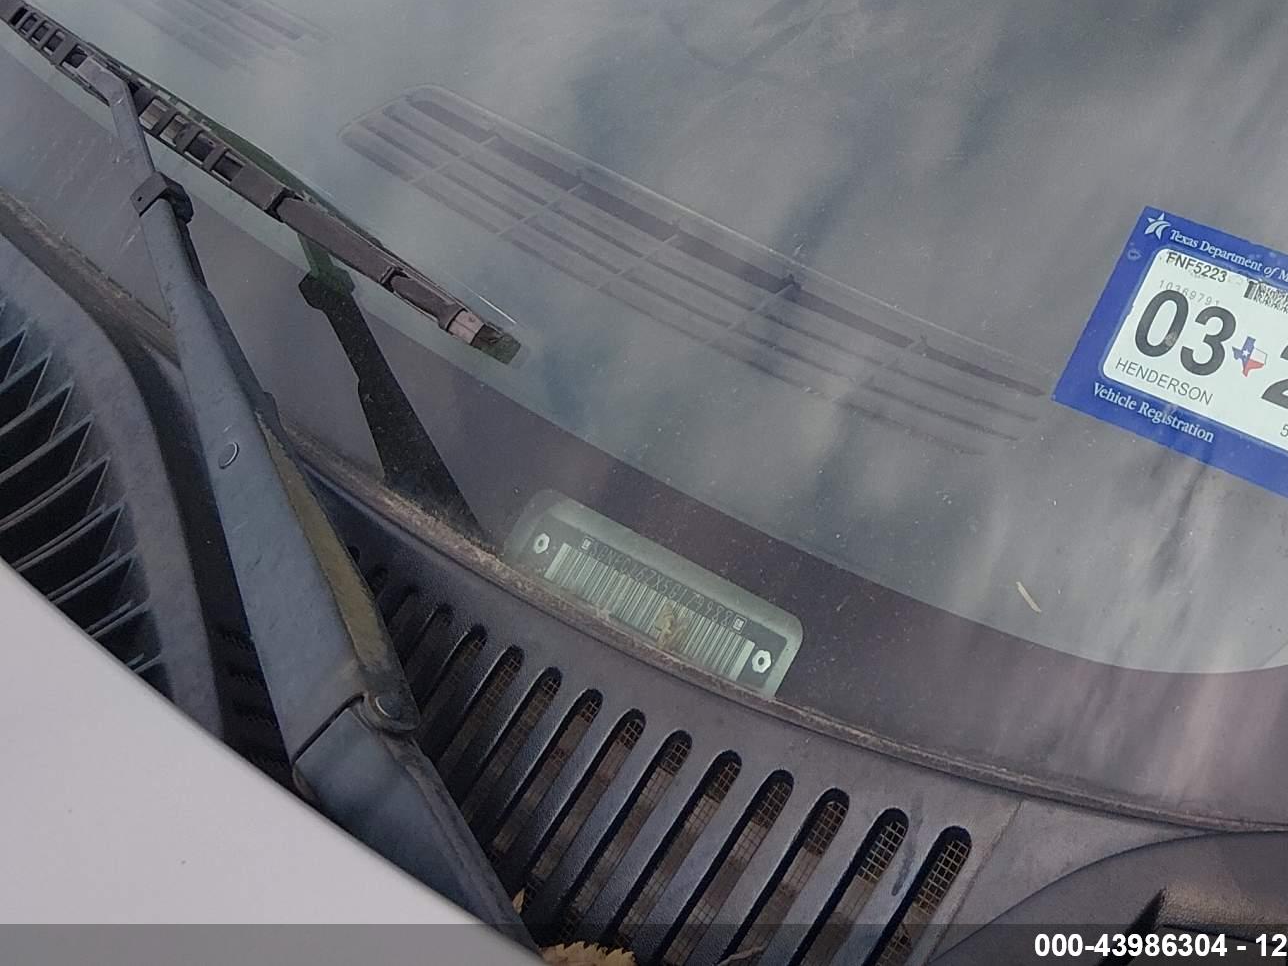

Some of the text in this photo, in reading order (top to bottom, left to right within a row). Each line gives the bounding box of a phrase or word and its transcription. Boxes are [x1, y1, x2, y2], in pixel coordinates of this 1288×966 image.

[1166, 251, 1228, 283] FNF5223
[1170, 229, 1199, 248] Texas
[1199, 240, 1263, 274] Department
[1263, 264, 1278, 278] of
[1134, 289, 1237, 376] 03
[1114, 356, 1214, 407] HENDERSON
[1093, 381, 1216, 443] Vehicle Registration
